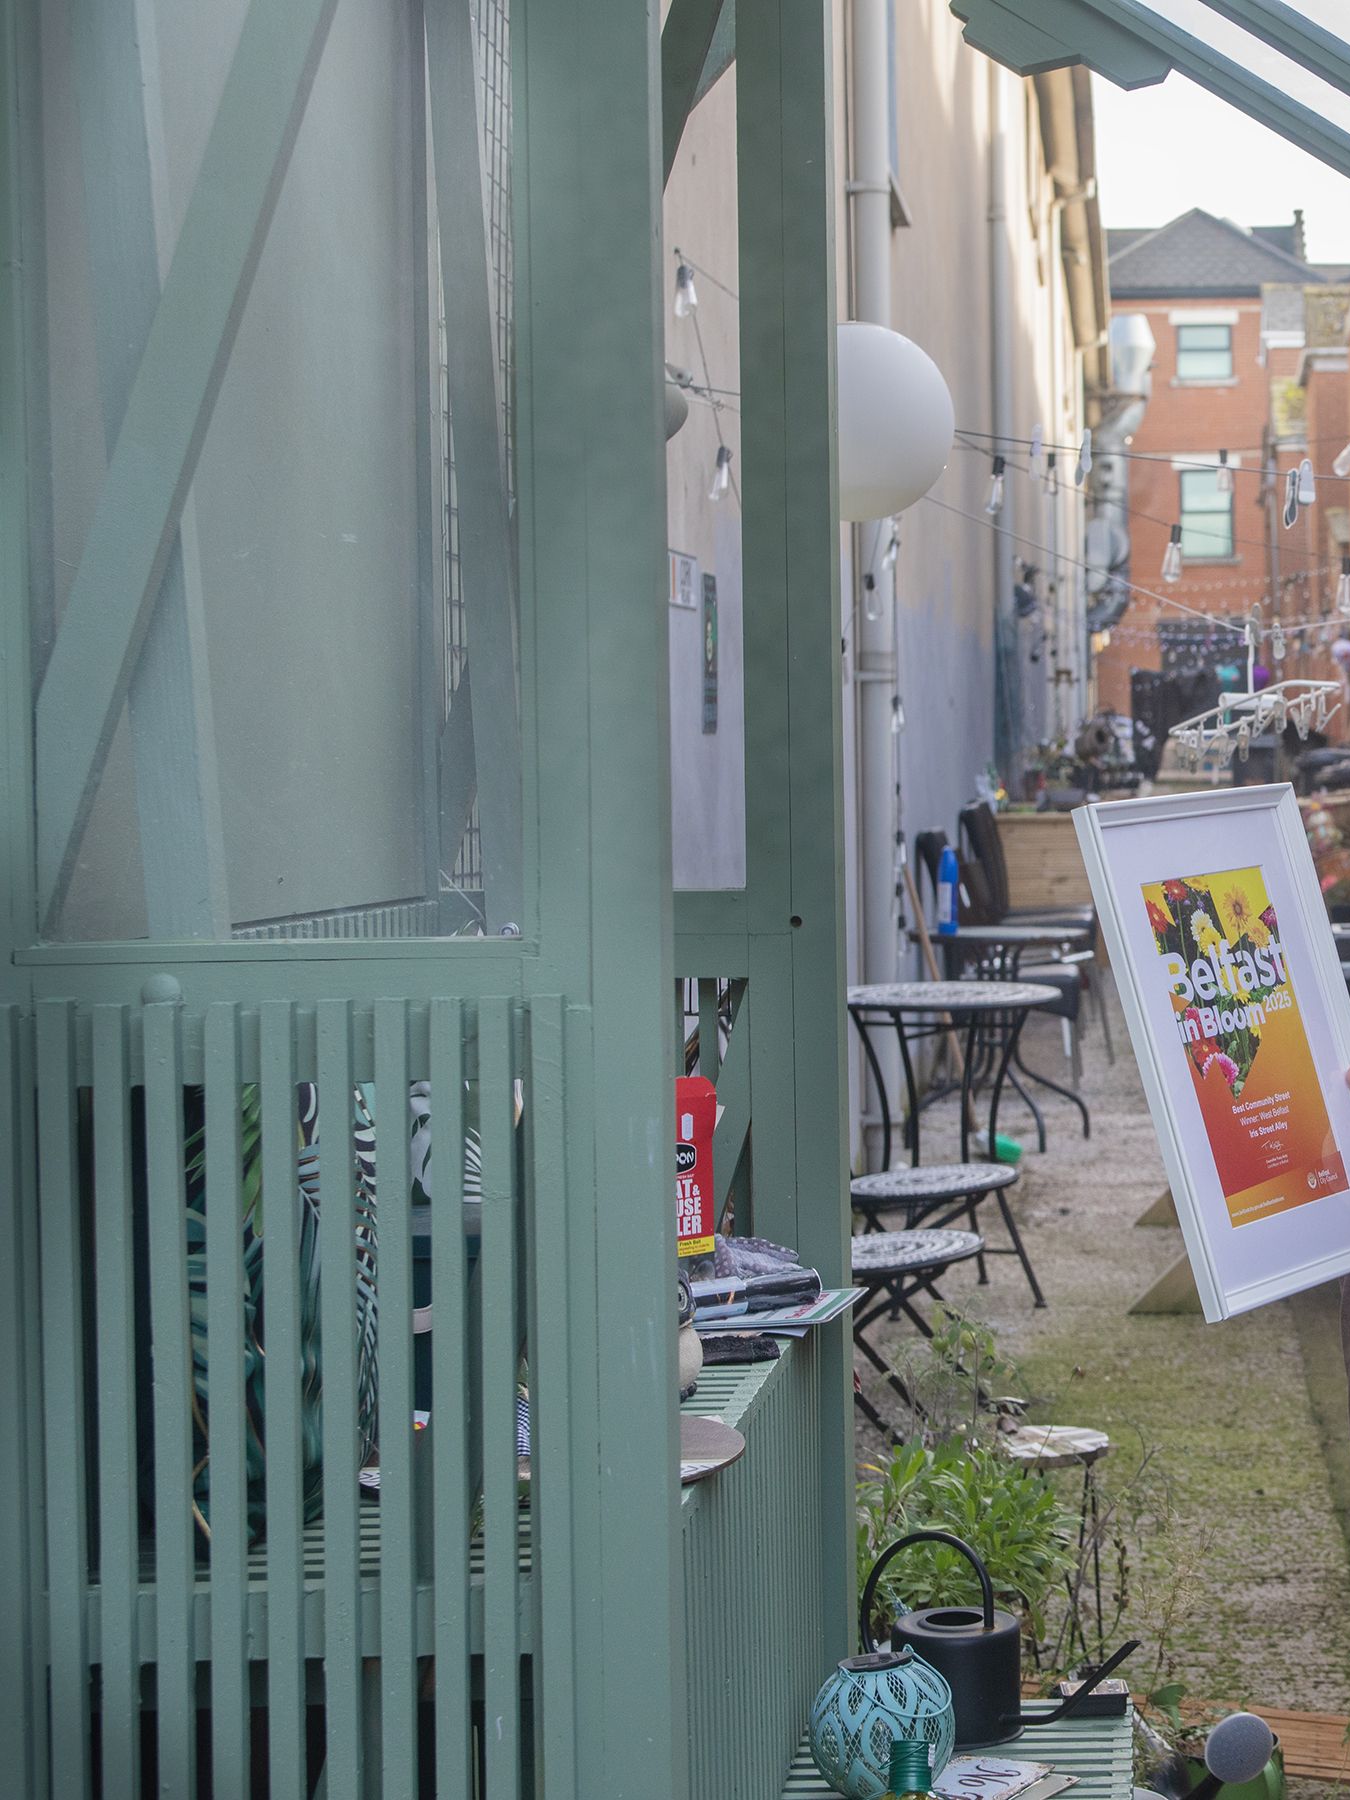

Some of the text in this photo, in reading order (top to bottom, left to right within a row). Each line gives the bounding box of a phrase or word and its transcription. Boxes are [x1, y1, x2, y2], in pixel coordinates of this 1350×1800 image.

[1160, 934, 1287, 1002] Belfast
[1175, 990, 1292, 1044] in Bloom 2025
[1231, 1090, 1291, 1114] Best Community Street
[1259, 1109, 1273, 1120] West
[1272, 1105, 1290, 1117] Belfast
[1248, 1120, 1288, 1139] Iris Street Alley
[676, 1178, 700, 1199] AT &
[676, 1196, 702, 1218] USE
[676, 1215, 702, 1237] LER
